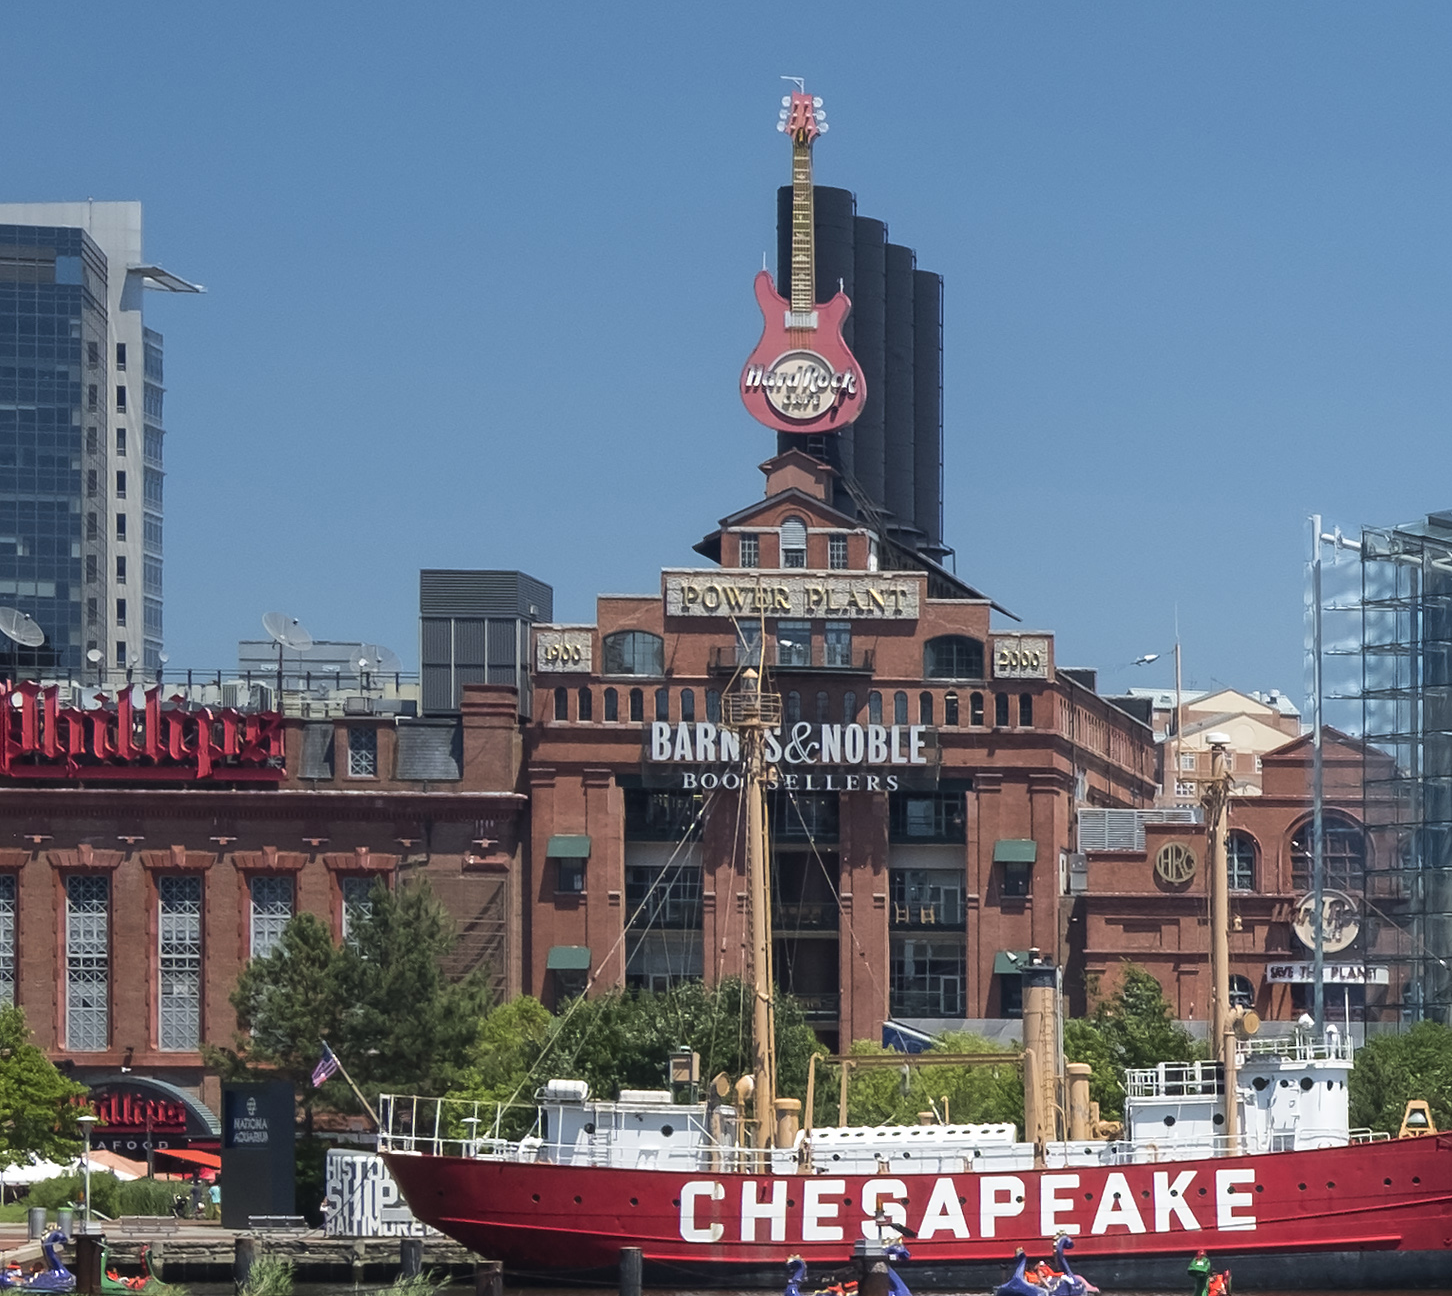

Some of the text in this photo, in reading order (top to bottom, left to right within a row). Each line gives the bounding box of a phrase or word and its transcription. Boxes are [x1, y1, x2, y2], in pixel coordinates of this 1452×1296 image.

[680, 584, 907, 614] POWER PLANT
[998, 649, 1041, 667] 2000
[682, 771, 899, 791] BOOSELLERS
[1270, 965, 1294, 979] SAVE
[326, 1179, 406, 1220] SHIP
[679, 1168, 1257, 1243] CHESAPEAKE
